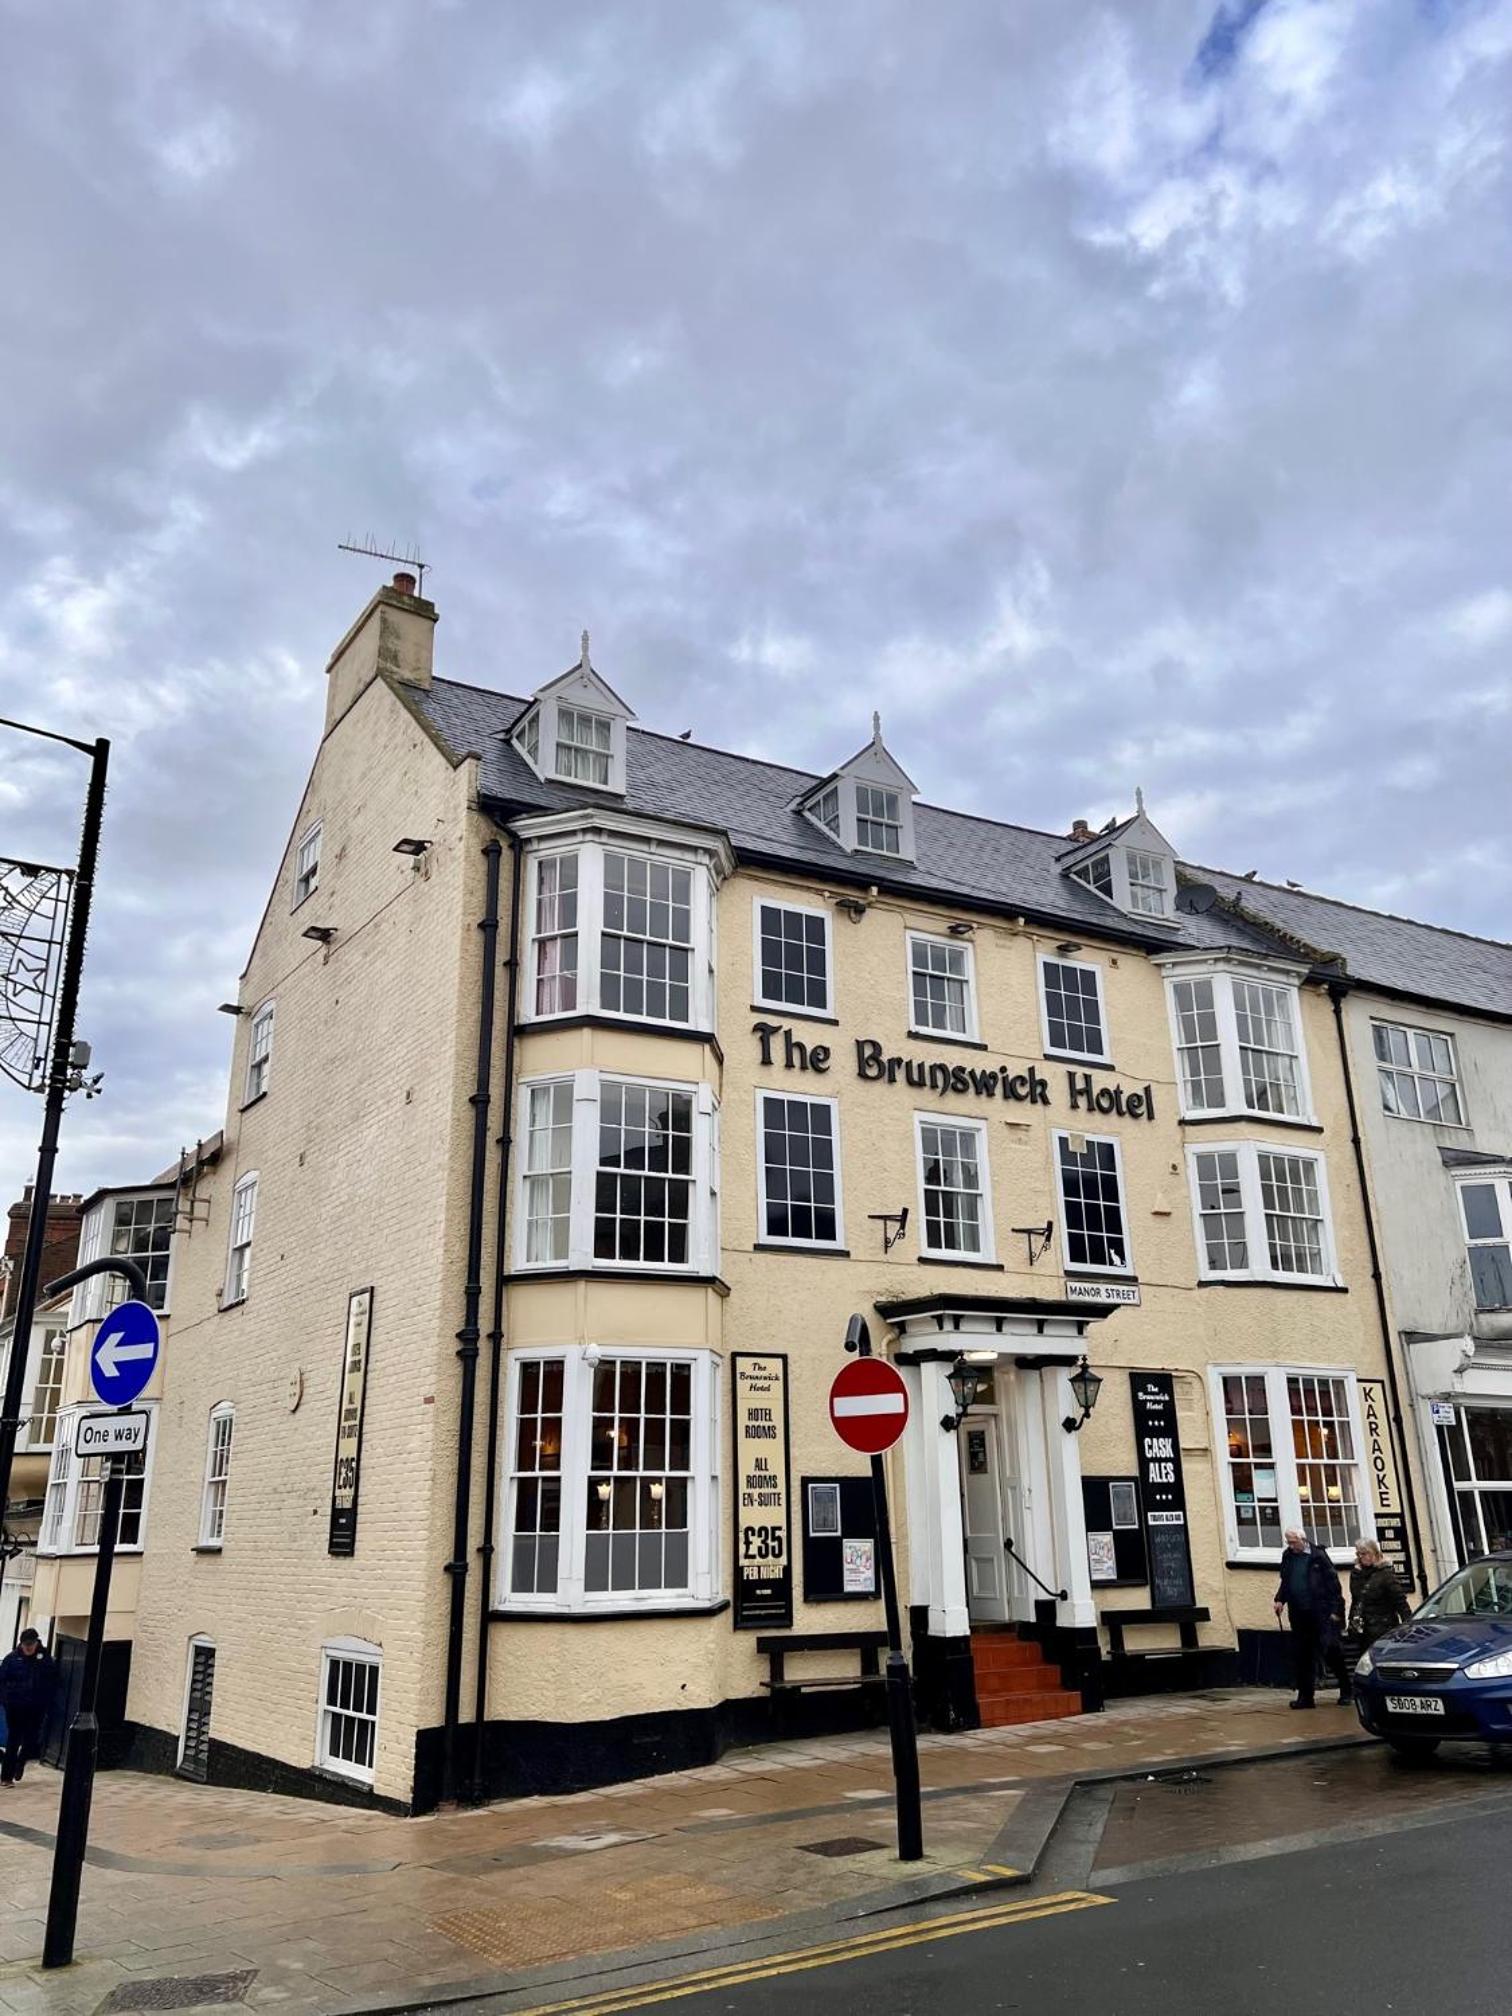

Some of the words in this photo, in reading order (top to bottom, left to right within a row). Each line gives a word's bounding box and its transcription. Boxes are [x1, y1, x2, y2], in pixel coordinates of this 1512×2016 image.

[752, 1022, 831, 1073] The
[855, 1038, 1052, 1107] Brunswick
[1066, 1070, 1155, 1121] Hotel
[1069, 1285, 1102, 1298] MANOR
[1105, 1288, 1137, 1300] STREET
[752, 1362, 767, 1371] The
[749, 1382, 771, 1392] Hotel
[748, 1408, 773, 1422] HOTEL
[84, 1426, 110, 1444] One
[114, 1426, 141, 1444] way
[745, 1425, 777, 1439] ROOMS
[1144, 1437, 1174, 1458] CASK
[1362, 1386, 1391, 1508] KARAOKE
[754, 1457, 769, 1471] ALL
[1149, 1462, 1175, 1483] ALES
[746, 1475, 778, 1489] ROOMS
[743, 1492, 782, 1507] EN-SUITE
[743, 1526, 783, 1559] £35
[743, 1566, 759, 1580] PER
[760, 1566, 784, 1579] NIGHT
